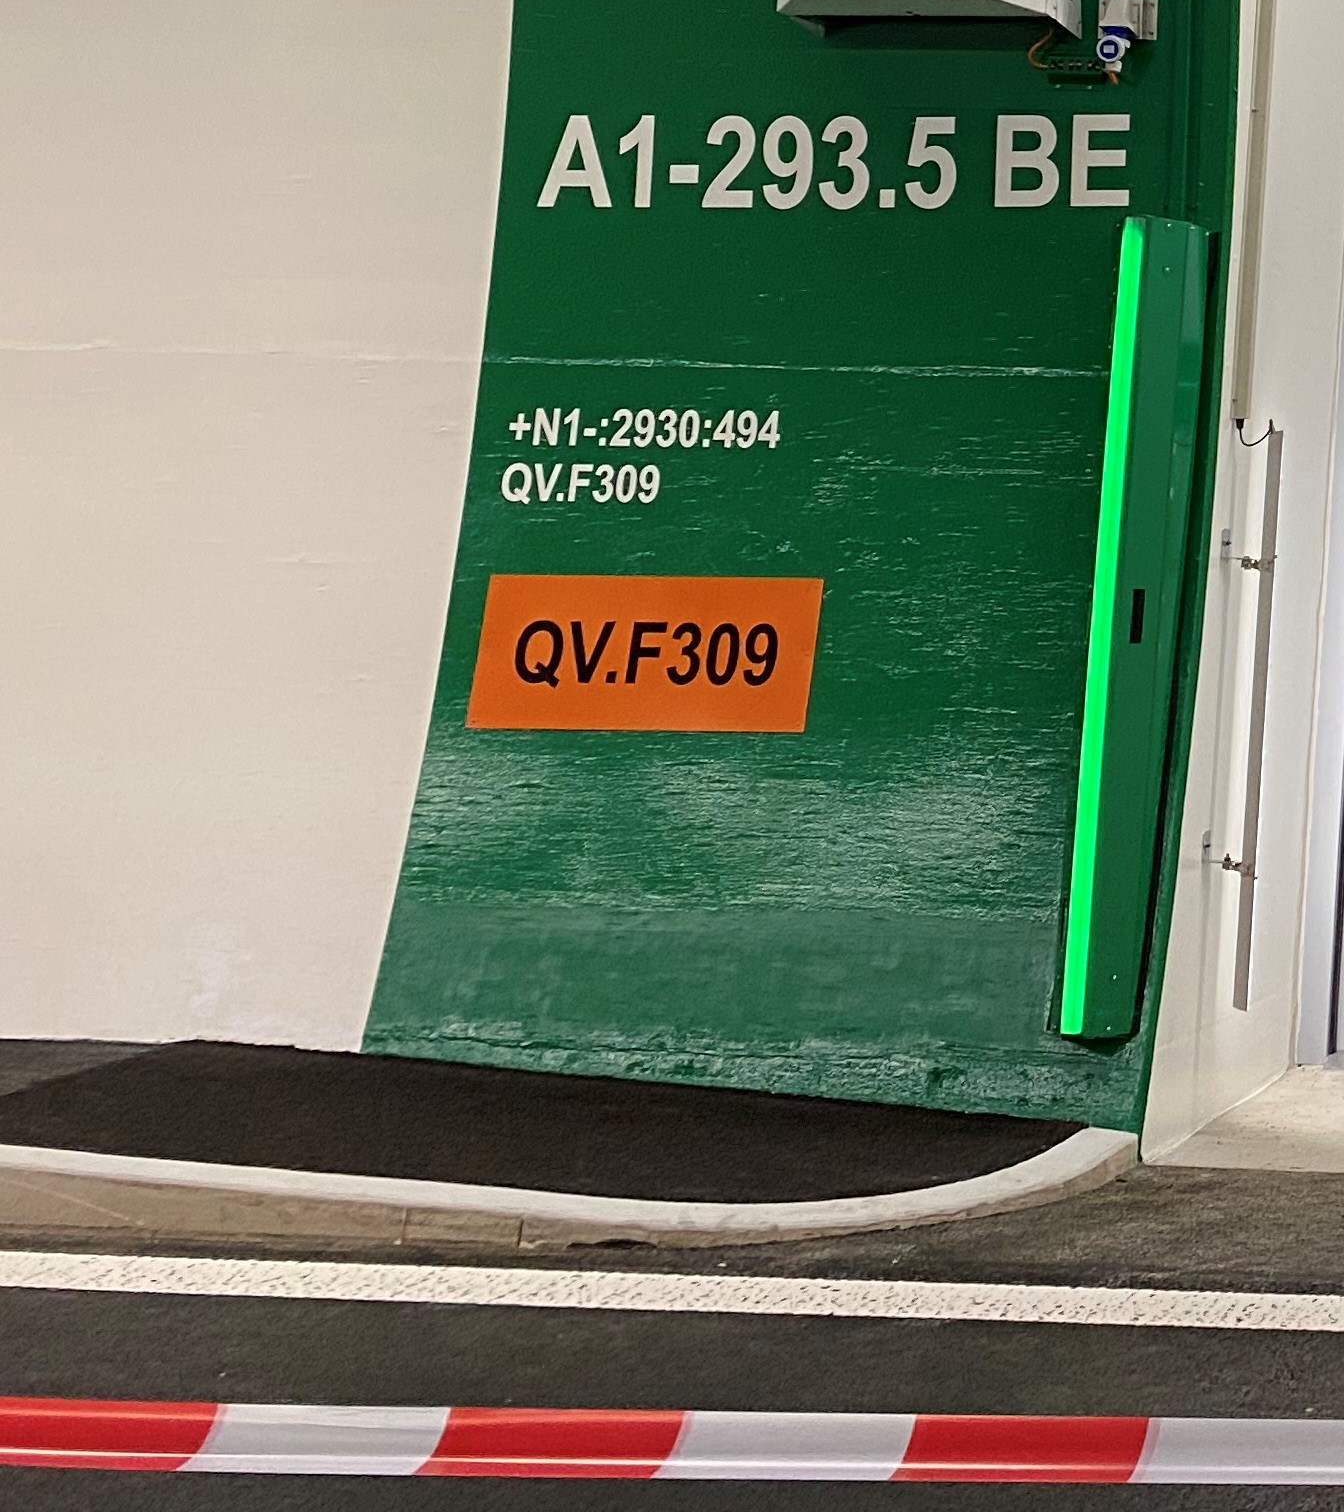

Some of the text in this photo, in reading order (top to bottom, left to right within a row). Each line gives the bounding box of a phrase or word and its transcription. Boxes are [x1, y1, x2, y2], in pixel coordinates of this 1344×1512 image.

[536, 113, 1131, 210] A1-293.5 BE
[508, 407, 781, 449] +N1-:2930:494
[501, 462, 661, 505] QV.F309
[513, 618, 779, 689] QV.F309
